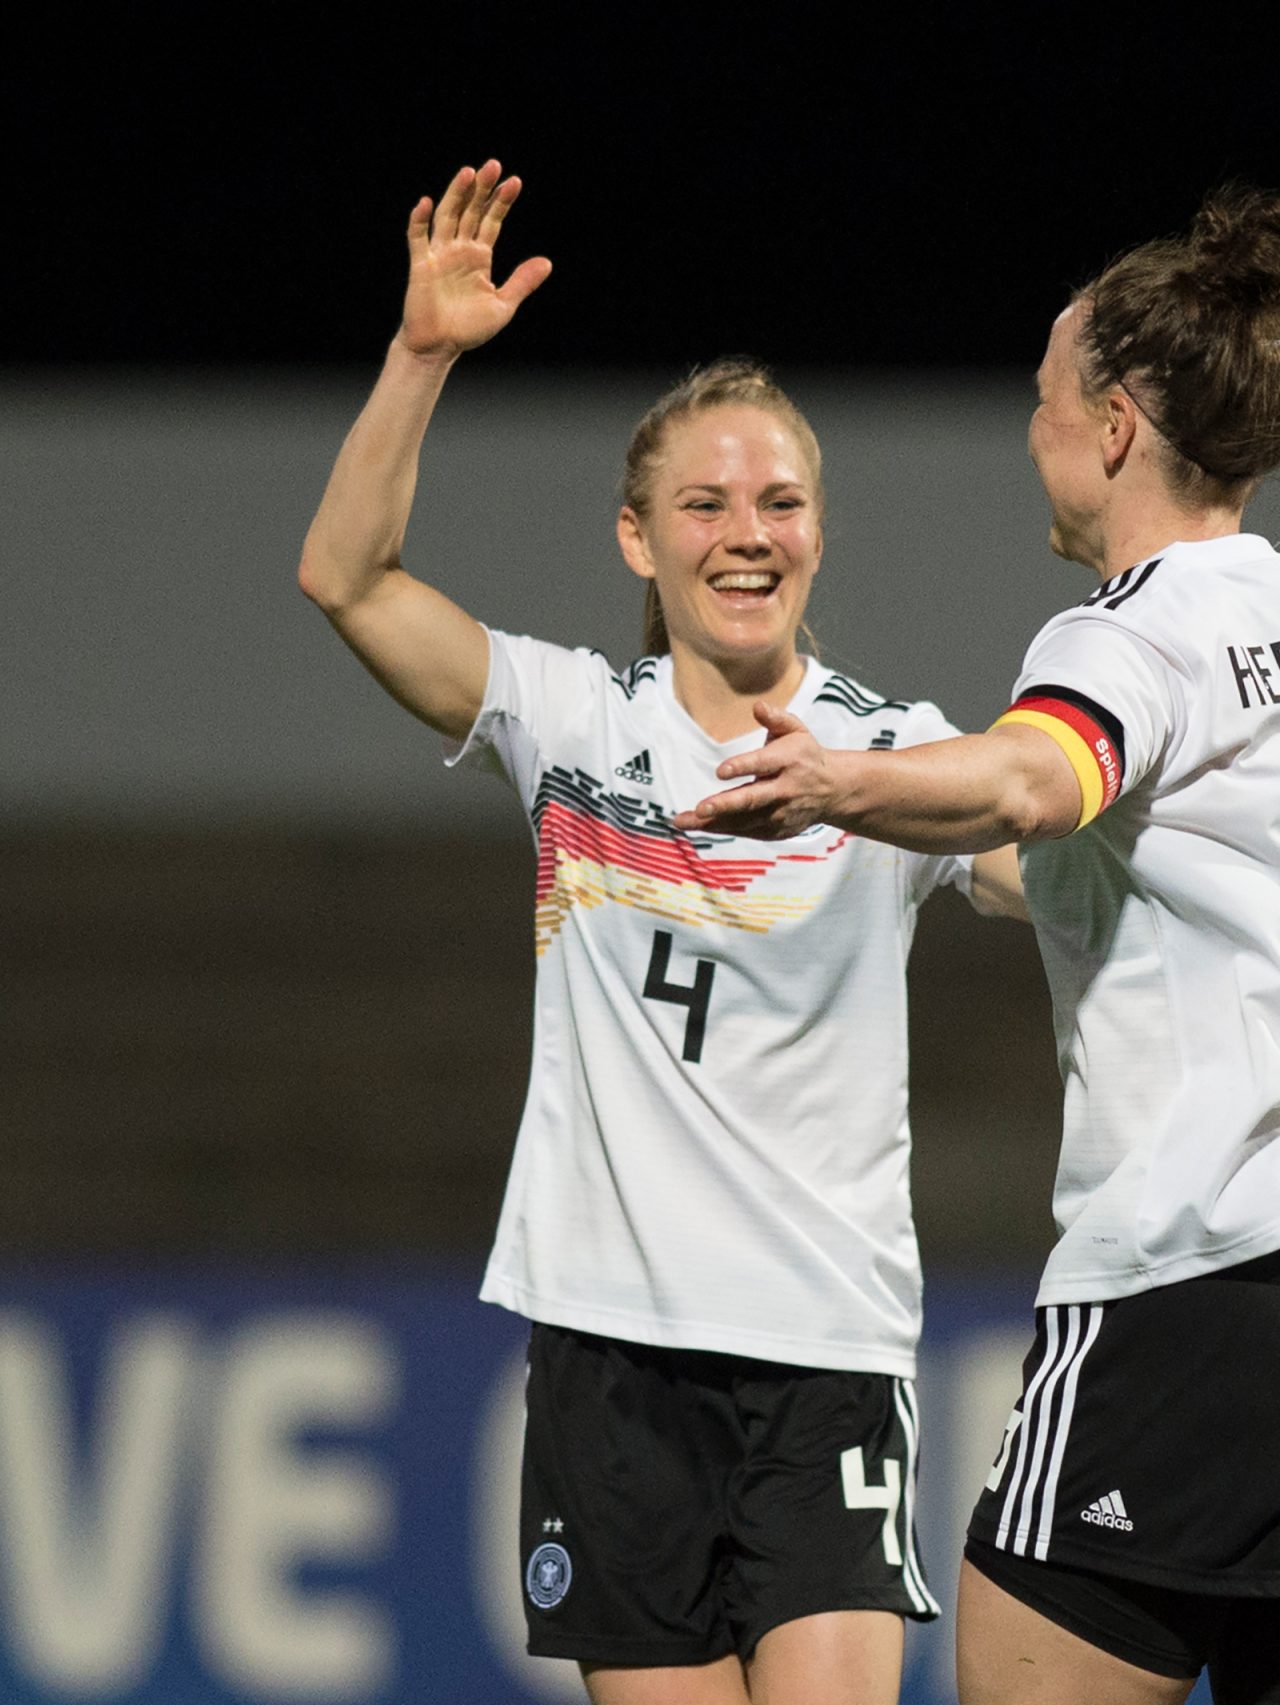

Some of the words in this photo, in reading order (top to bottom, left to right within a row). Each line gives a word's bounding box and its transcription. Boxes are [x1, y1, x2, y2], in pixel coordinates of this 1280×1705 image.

[643, 930, 716, 1064] 4
[841, 1446, 902, 1565] 4
[1081, 1509, 1133, 1531] adidas
